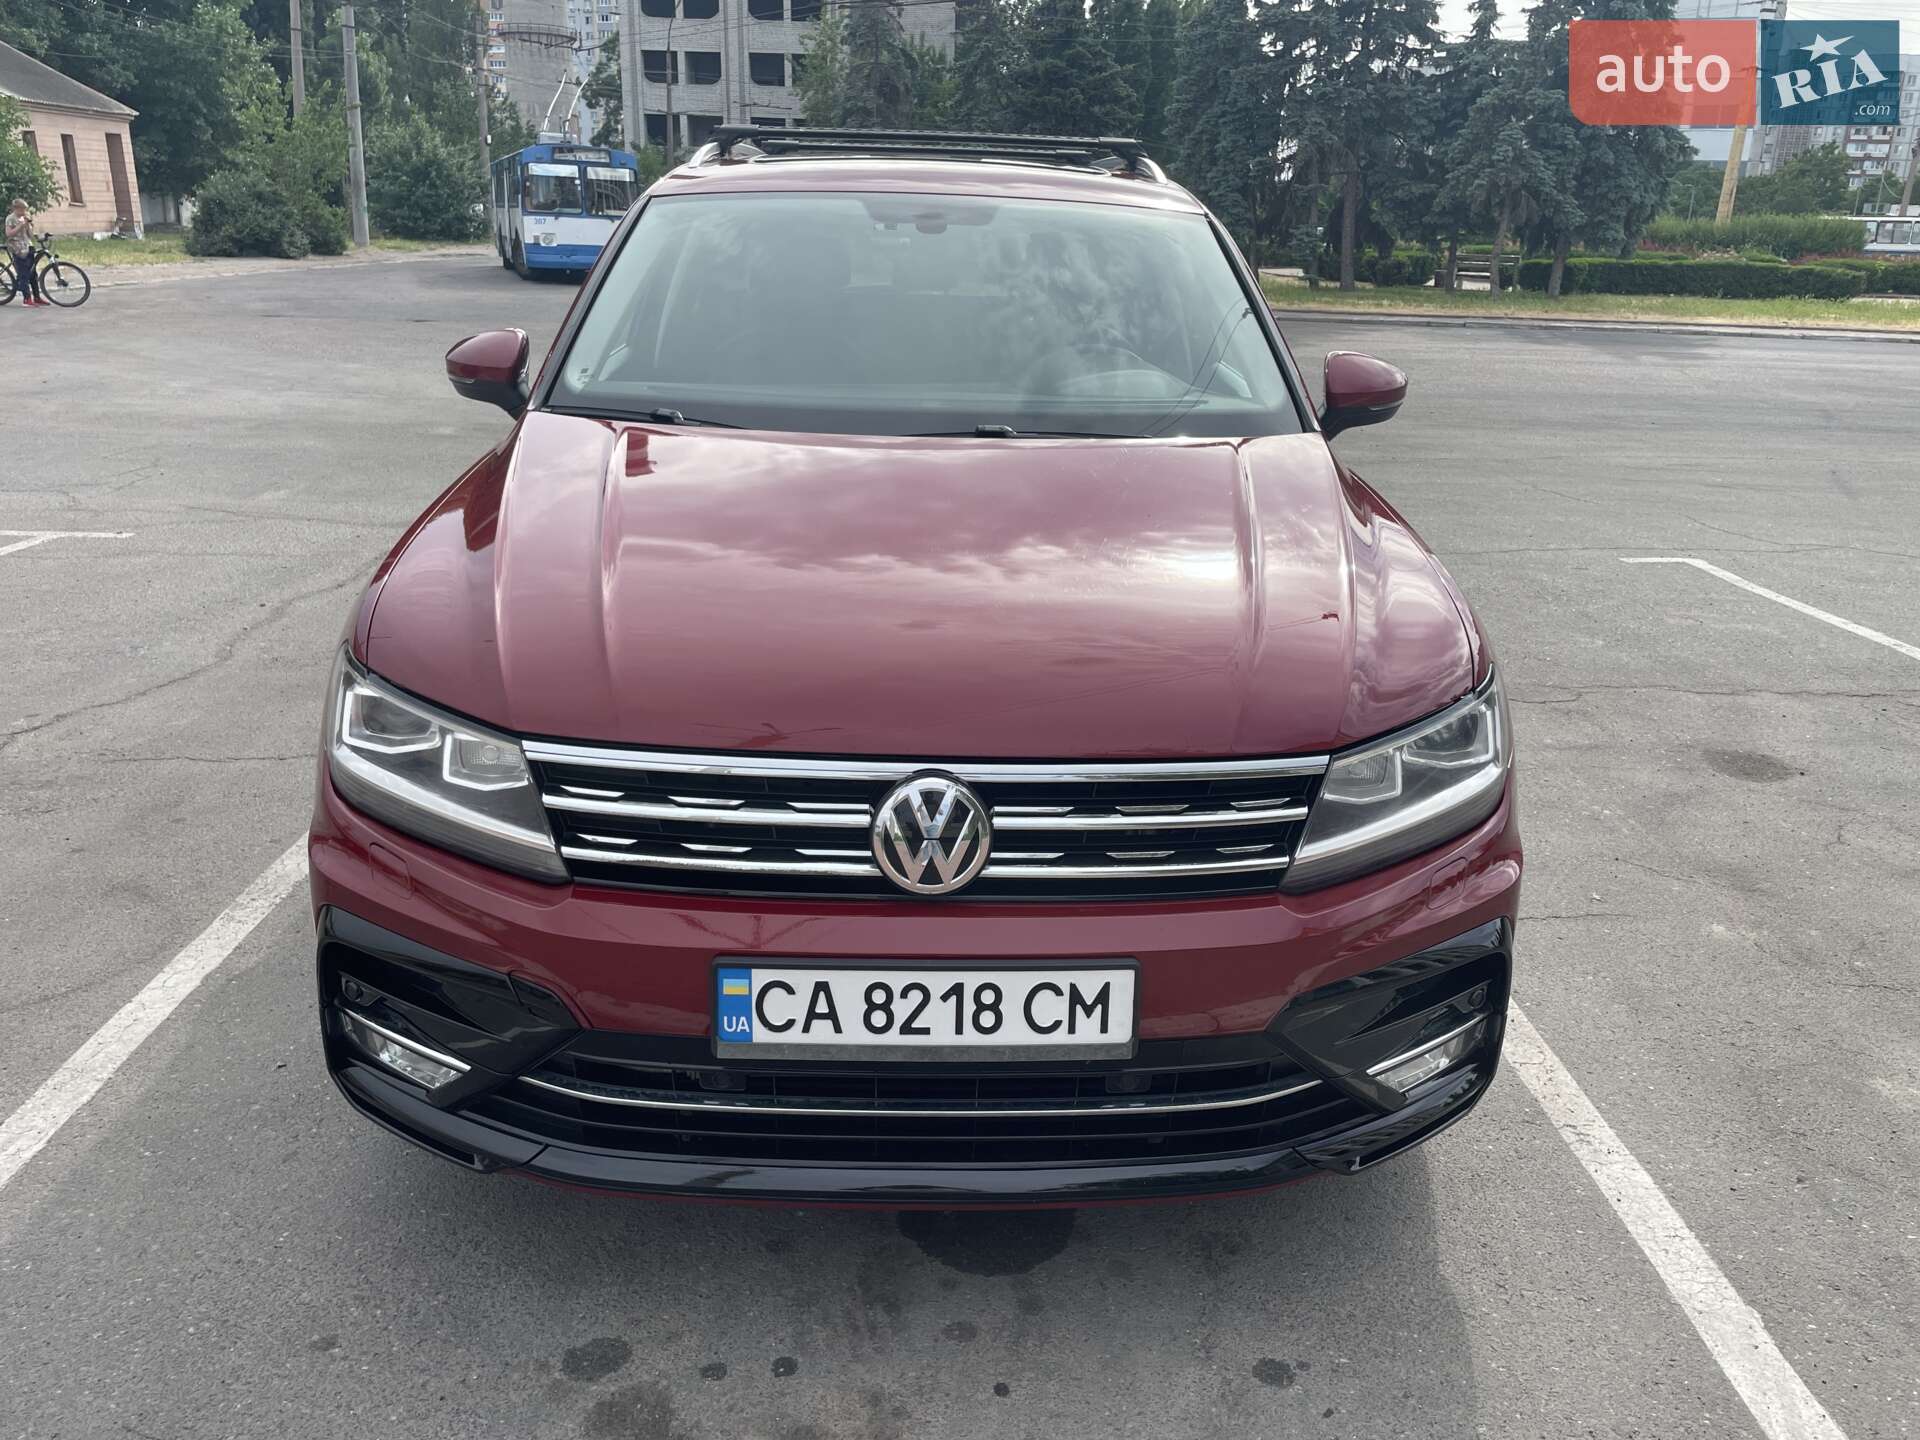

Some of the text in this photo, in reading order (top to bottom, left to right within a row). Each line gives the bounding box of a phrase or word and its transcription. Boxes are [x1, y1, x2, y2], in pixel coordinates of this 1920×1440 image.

[723, 1016, 750, 1034] UA
[755, 980, 1111, 1036] CA 8218 CM
